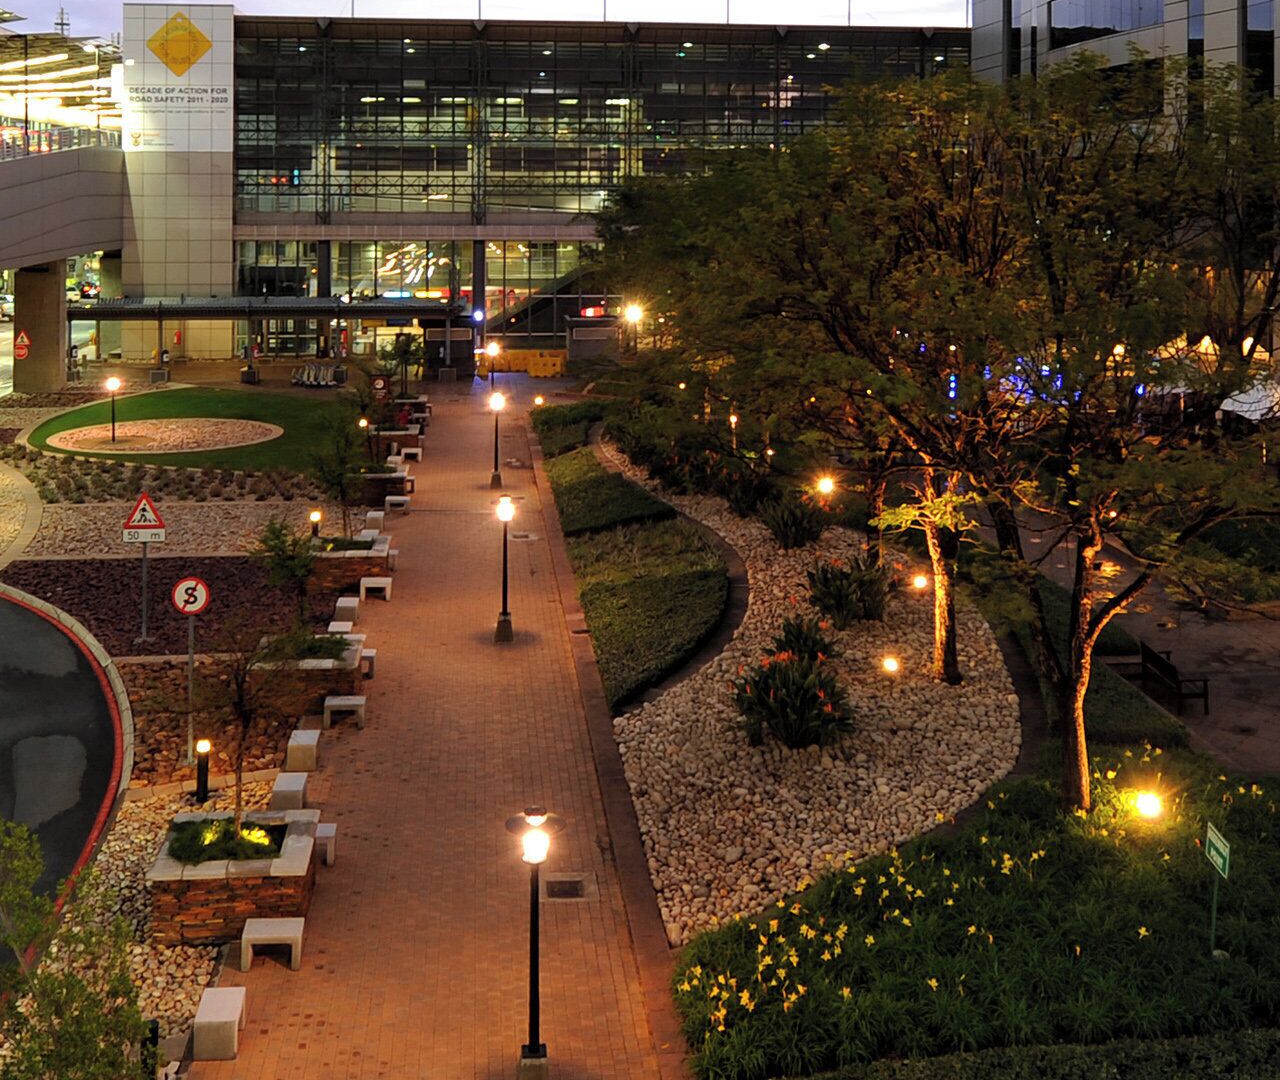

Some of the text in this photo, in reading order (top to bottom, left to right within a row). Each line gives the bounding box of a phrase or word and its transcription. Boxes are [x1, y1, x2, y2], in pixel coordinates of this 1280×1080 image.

[127, 531, 160, 540] 50 m
[183, 587, 198, 604] S
